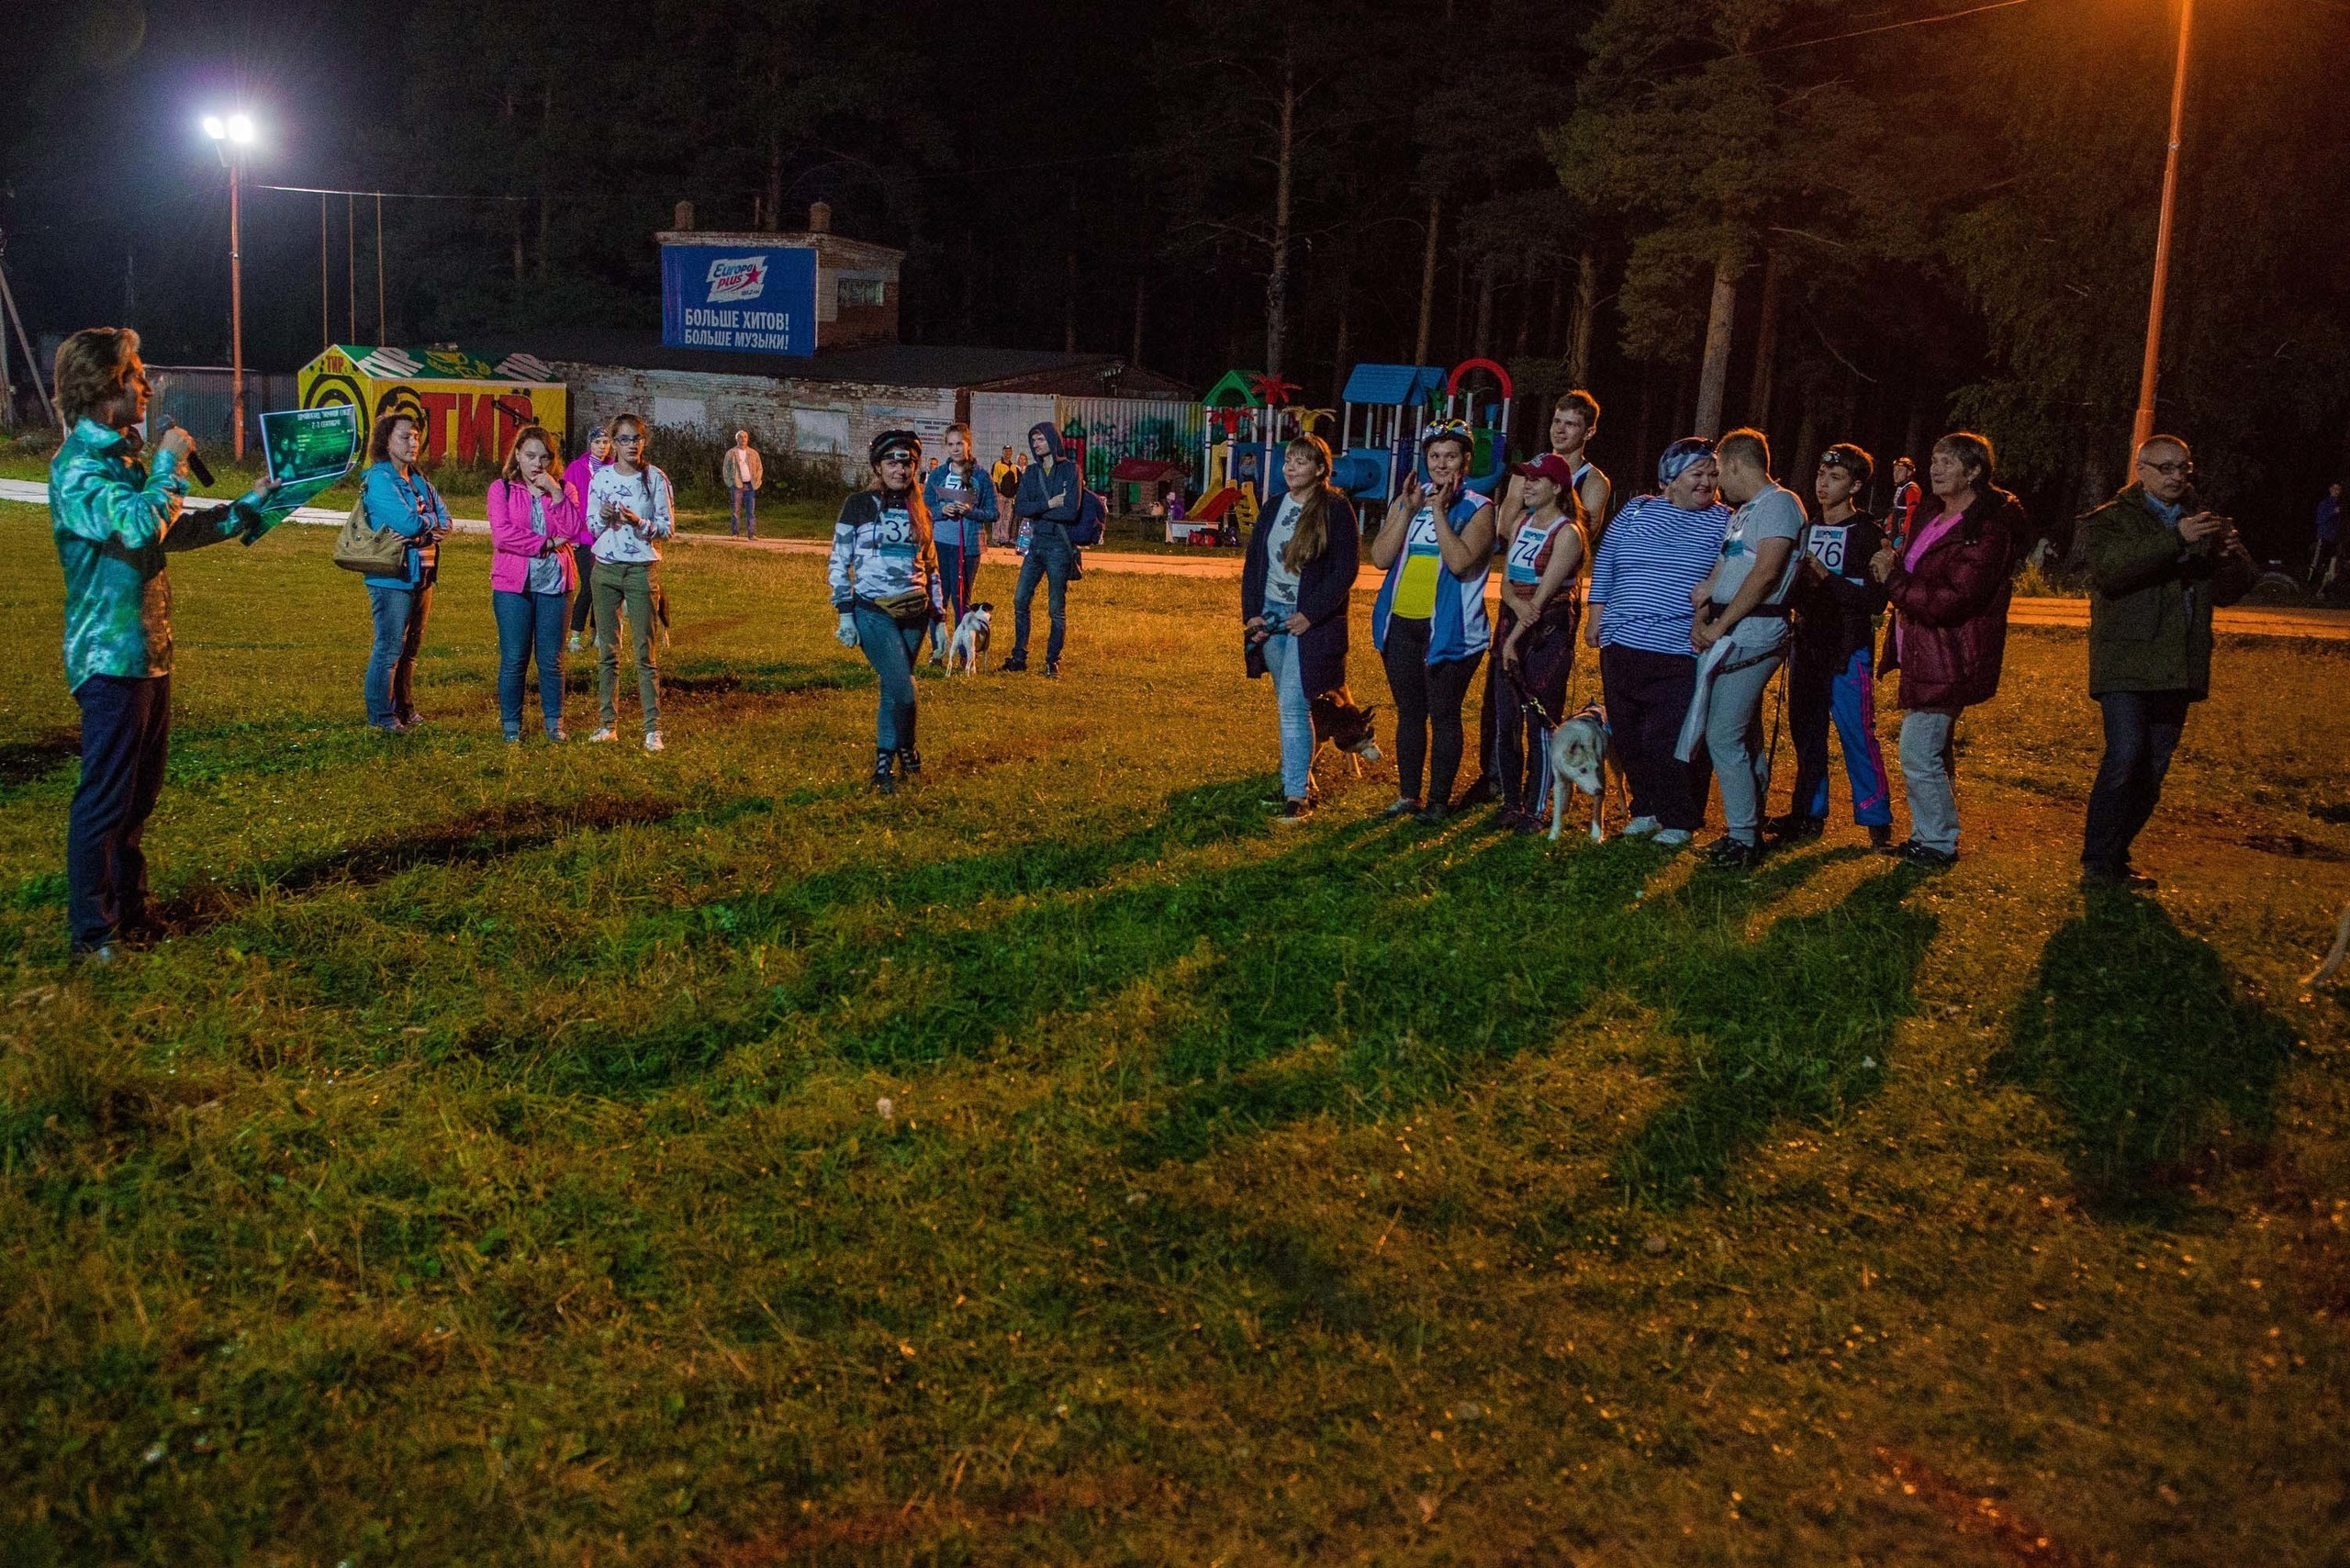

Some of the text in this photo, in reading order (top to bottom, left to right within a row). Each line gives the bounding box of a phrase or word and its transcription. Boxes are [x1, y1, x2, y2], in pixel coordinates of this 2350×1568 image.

[714, 263, 753, 277] Europa
[685, 308, 789, 330] БОЛЬШЕ ХИТОВ!
[685, 329, 789, 351] БОЛЬШЕ МУЗЫКИ!
[326, 356, 344, 373] ТИР
[356, 346, 425, 378] ТИР
[420, 392, 533, 465] ТИР
[1511, 540, 1540, 566] 74
[1811, 541, 1842, 567] 76
